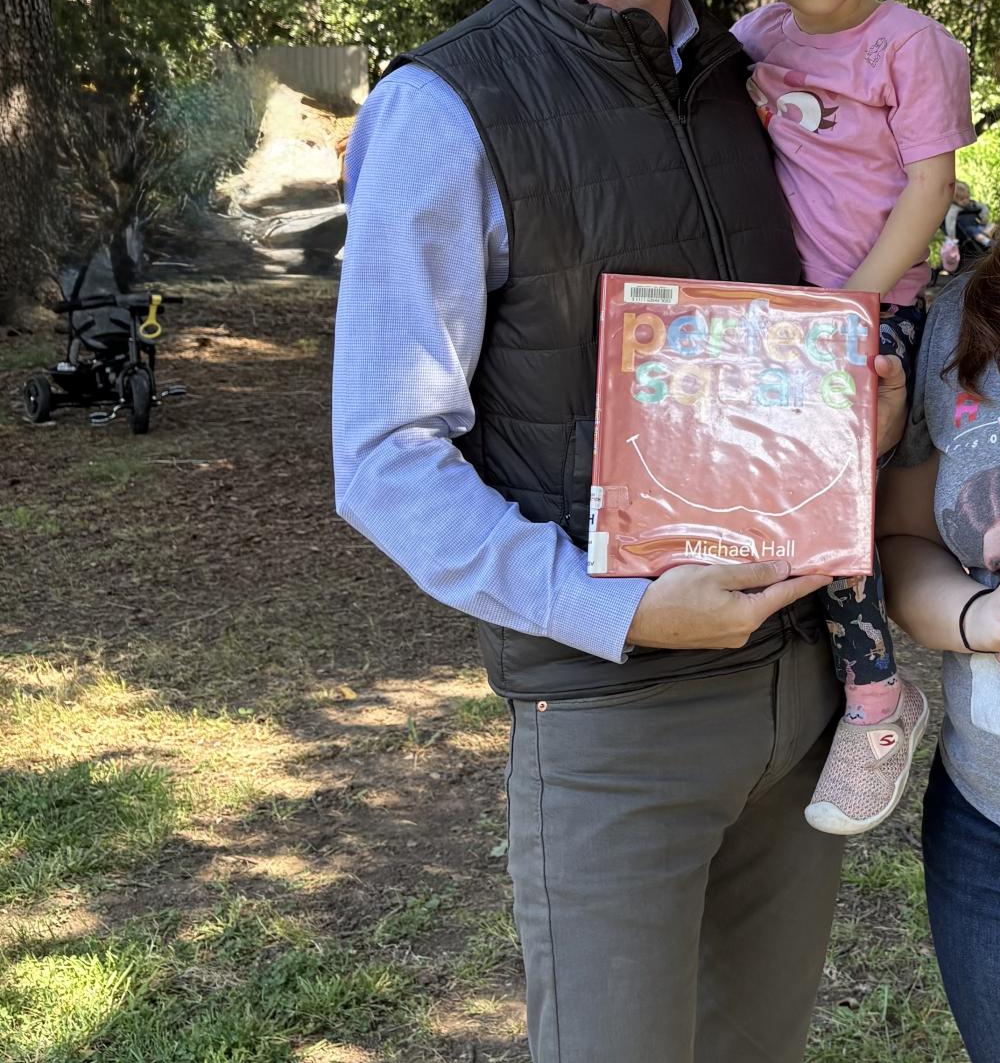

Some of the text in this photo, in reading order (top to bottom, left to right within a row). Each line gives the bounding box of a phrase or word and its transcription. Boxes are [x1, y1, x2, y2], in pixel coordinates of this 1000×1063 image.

[620, 298, 868, 373] perfect
[632, 360, 856, 424] square
[685, 538, 796, 558] Michael Hall
